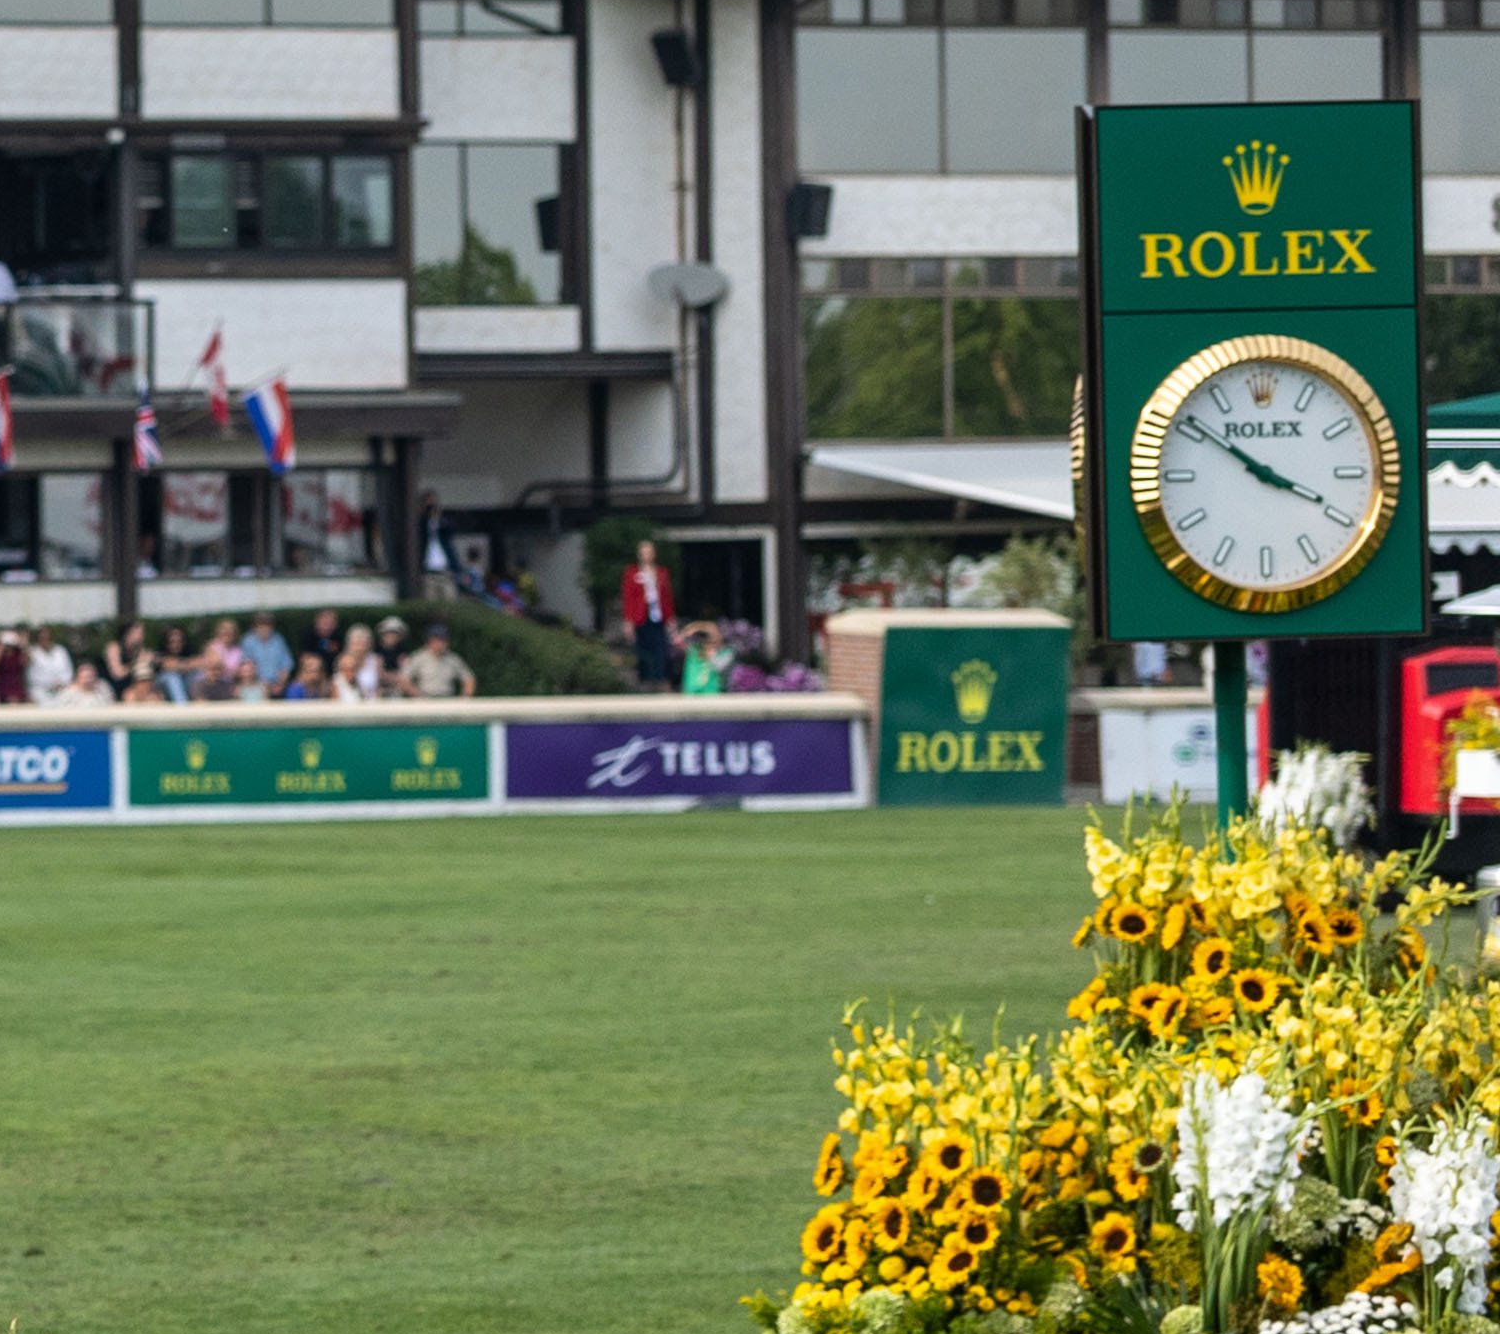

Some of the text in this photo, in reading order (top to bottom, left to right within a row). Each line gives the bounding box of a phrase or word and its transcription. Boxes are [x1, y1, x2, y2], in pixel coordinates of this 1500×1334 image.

[1140, 229, 1376, 278] ROLEX
[1224, 421, 1302, 438] ROLEX
[658, 740, 776, 775] TELUS
[895, 731, 1045, 773] ROLEX
